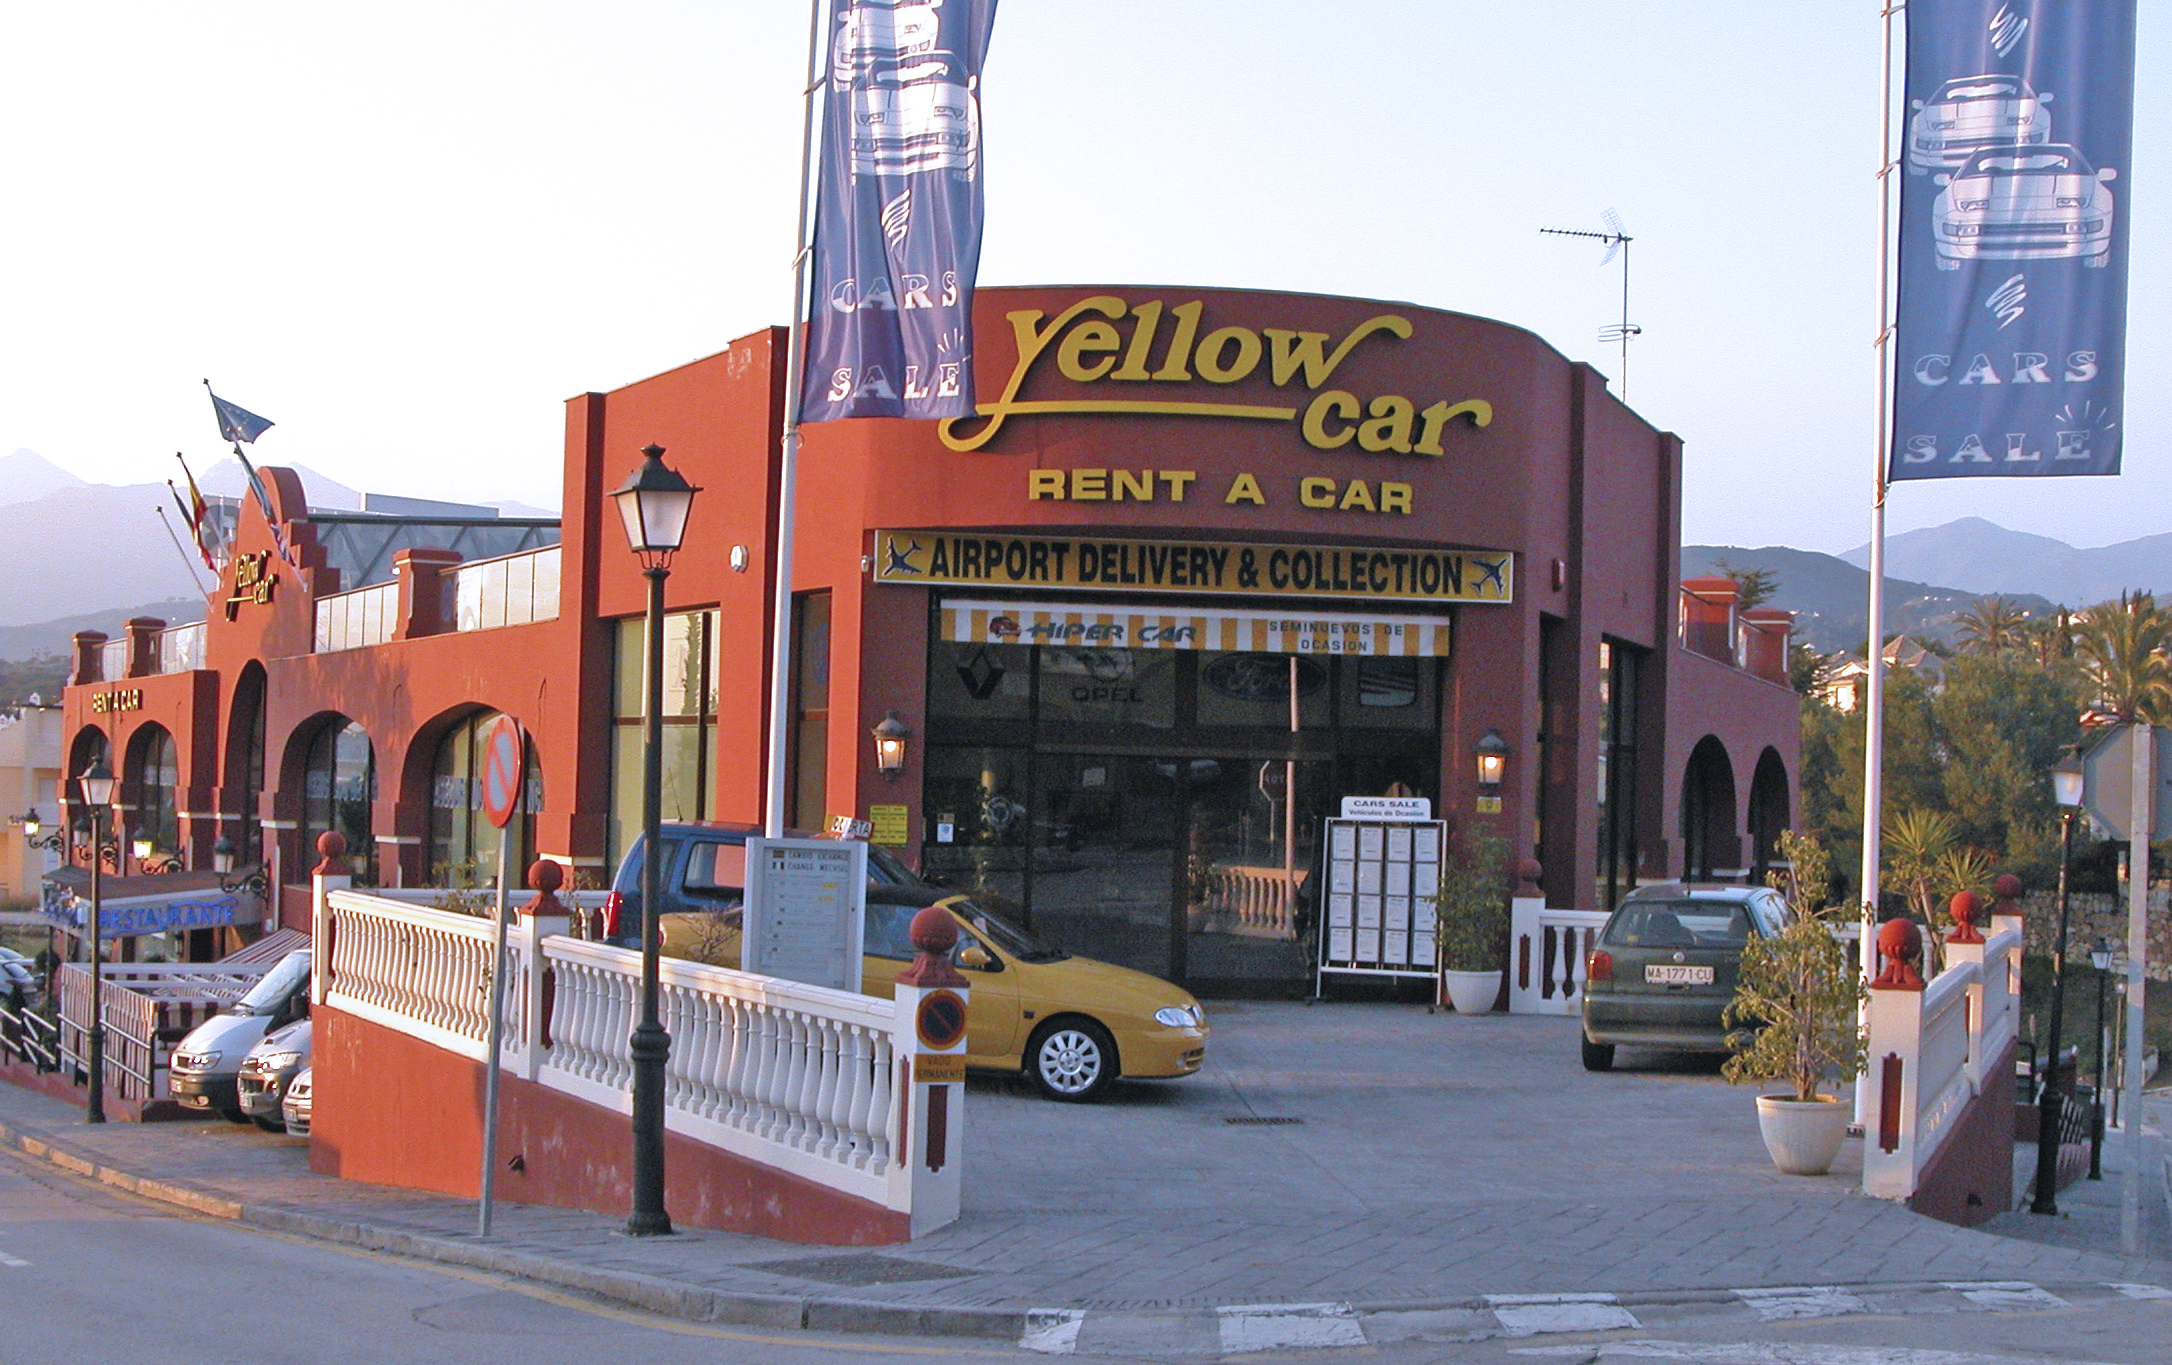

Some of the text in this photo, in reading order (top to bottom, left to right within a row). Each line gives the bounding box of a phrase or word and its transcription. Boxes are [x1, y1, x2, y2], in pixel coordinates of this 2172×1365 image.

[830, 271, 958, 314] CARS
[827, 362, 961, 402] SALE
[1913, 350, 2098, 386] CARS
[1903, 430, 2092, 464] SALE
[1029, 468, 1413, 514] RENT A CAR
[928, 537, 1464, 595] AIRPORT DELIVERY & COLLECTION
[1025, 622, 1197, 642] HIPER CAR
[1269, 621, 1403, 636] SEMINUEVOS DE
[1301, 639, 1367, 651] OCASION
[1071, 686, 1143, 702] OPEL
[99, 904, 234, 929] RESTAURANTE
